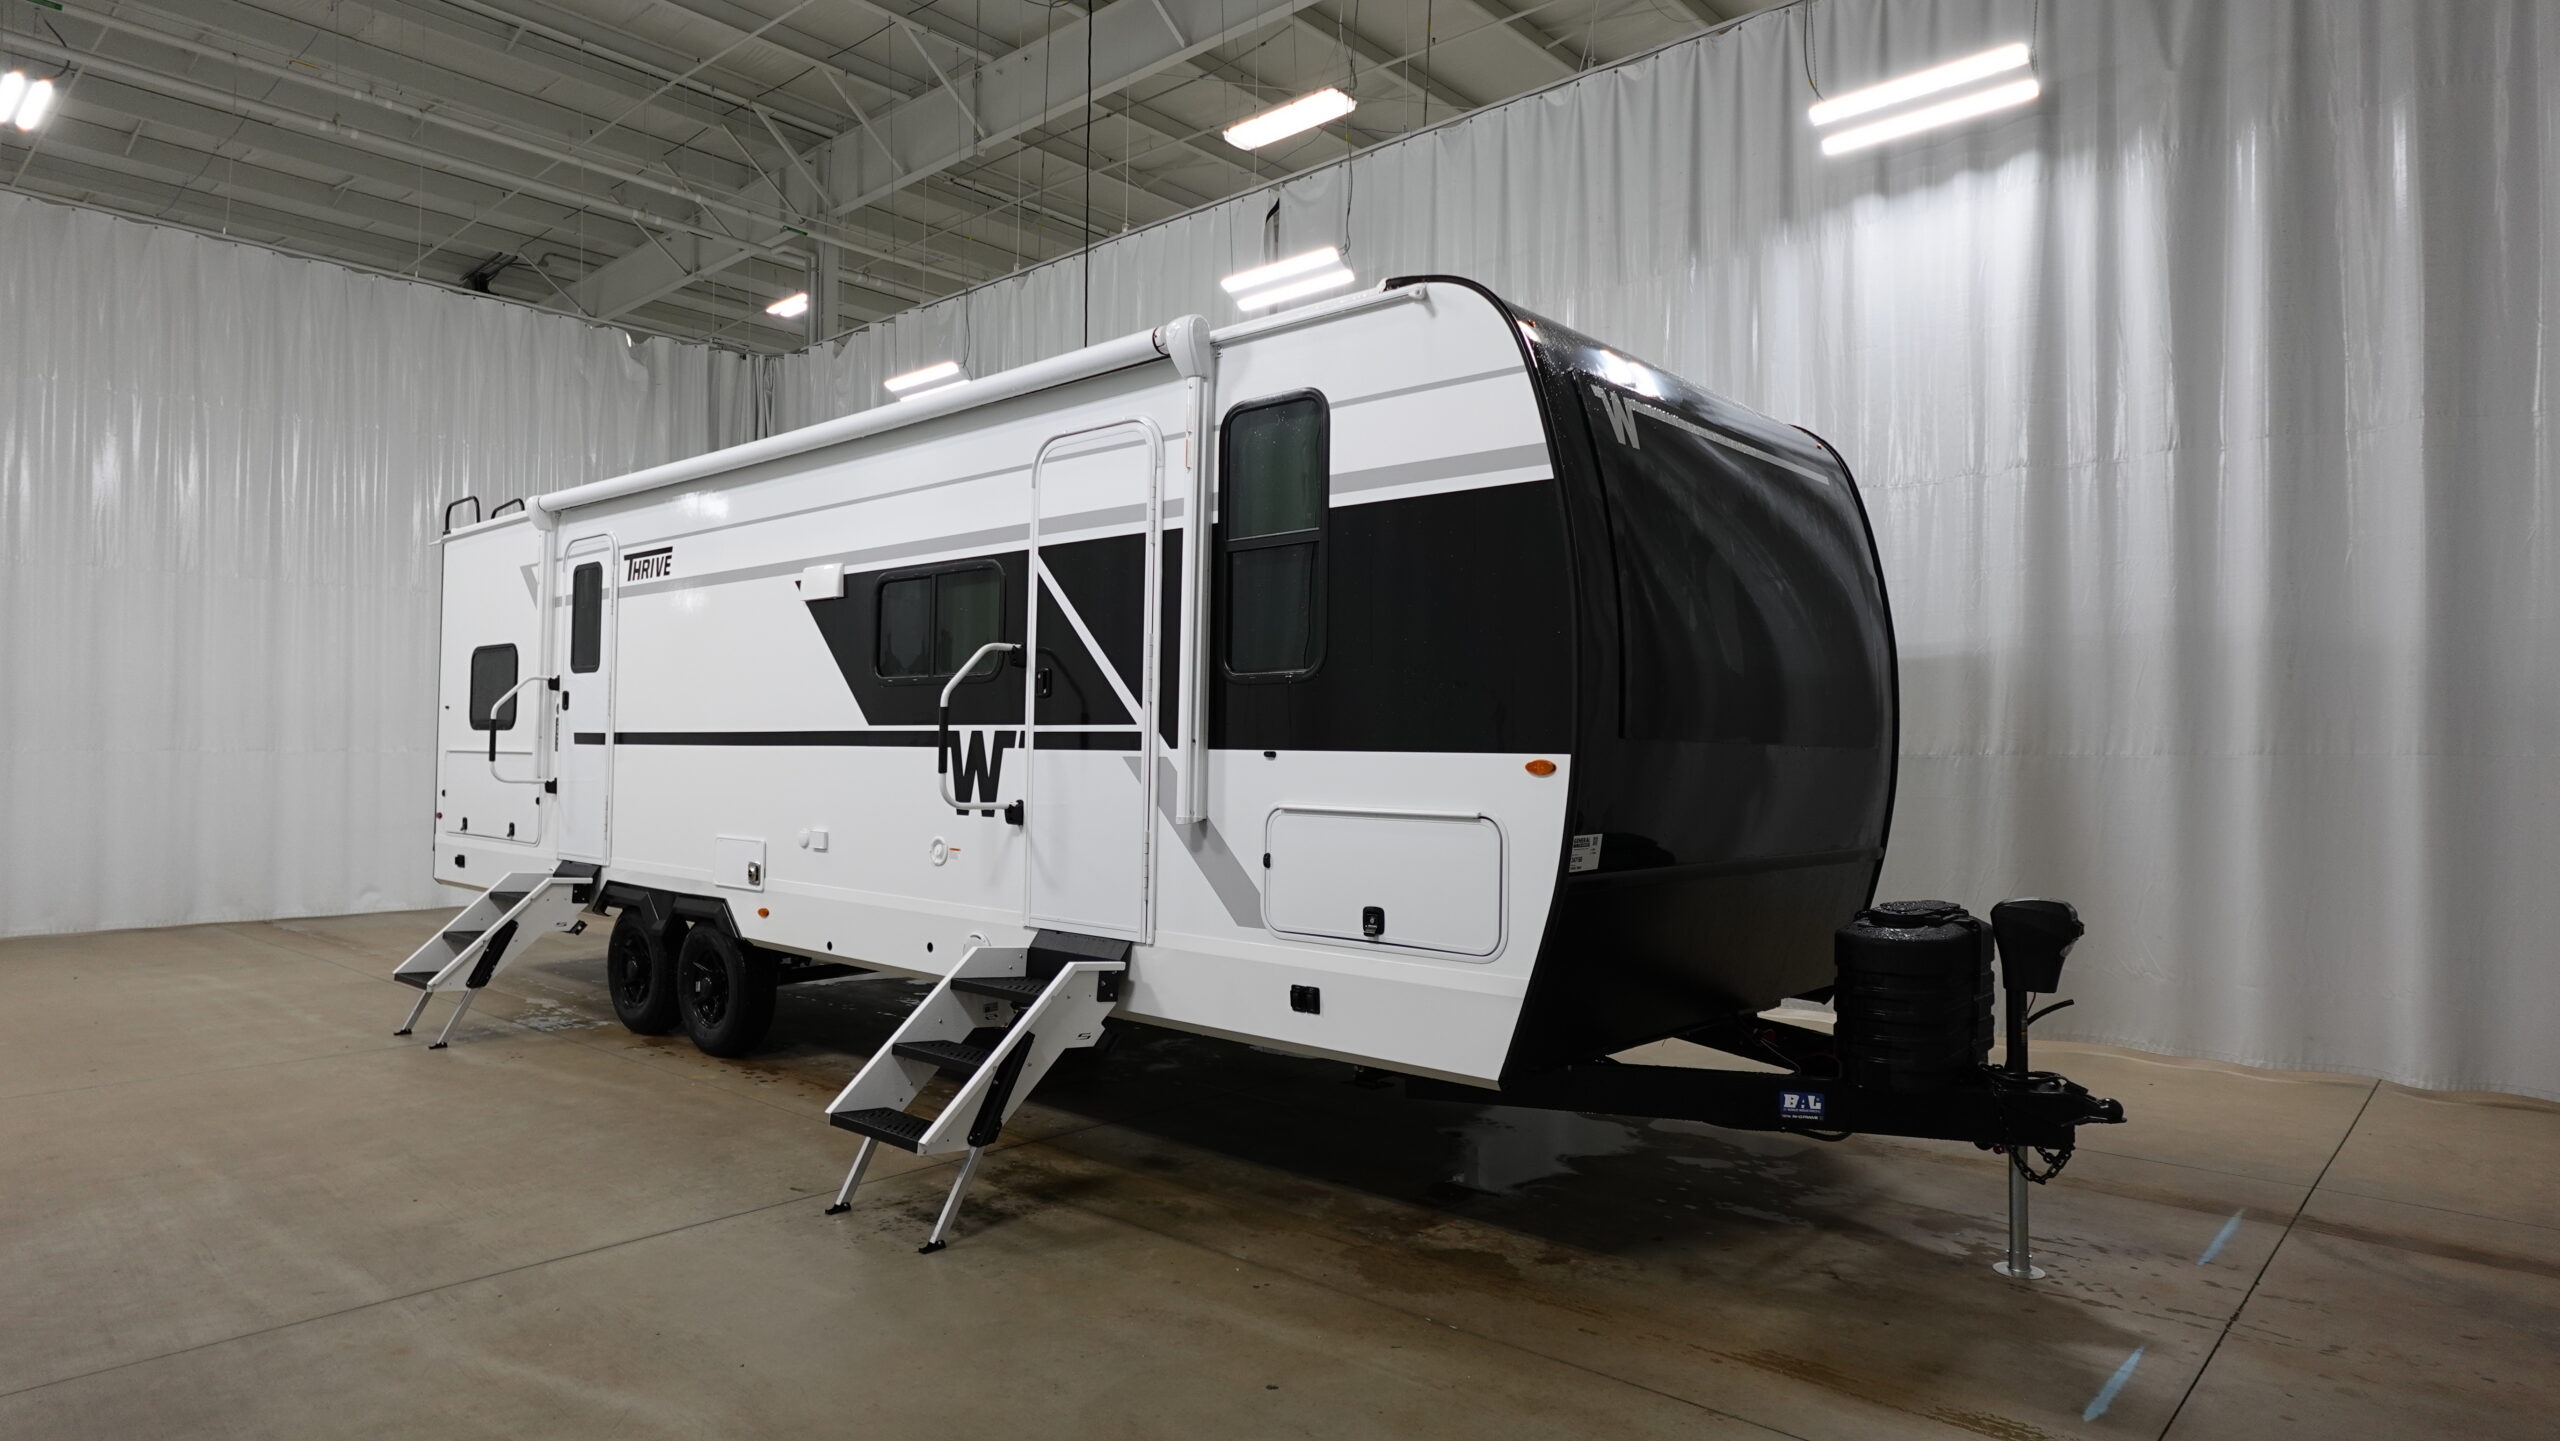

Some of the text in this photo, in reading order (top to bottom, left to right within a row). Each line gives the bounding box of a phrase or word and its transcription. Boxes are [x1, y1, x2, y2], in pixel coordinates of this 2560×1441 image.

[1590, 384, 1640, 450] W
[624, 546, 673, 582] THRIVE
[943, 730, 1017, 818] W
[1783, 1094, 1822, 1110] BAL
